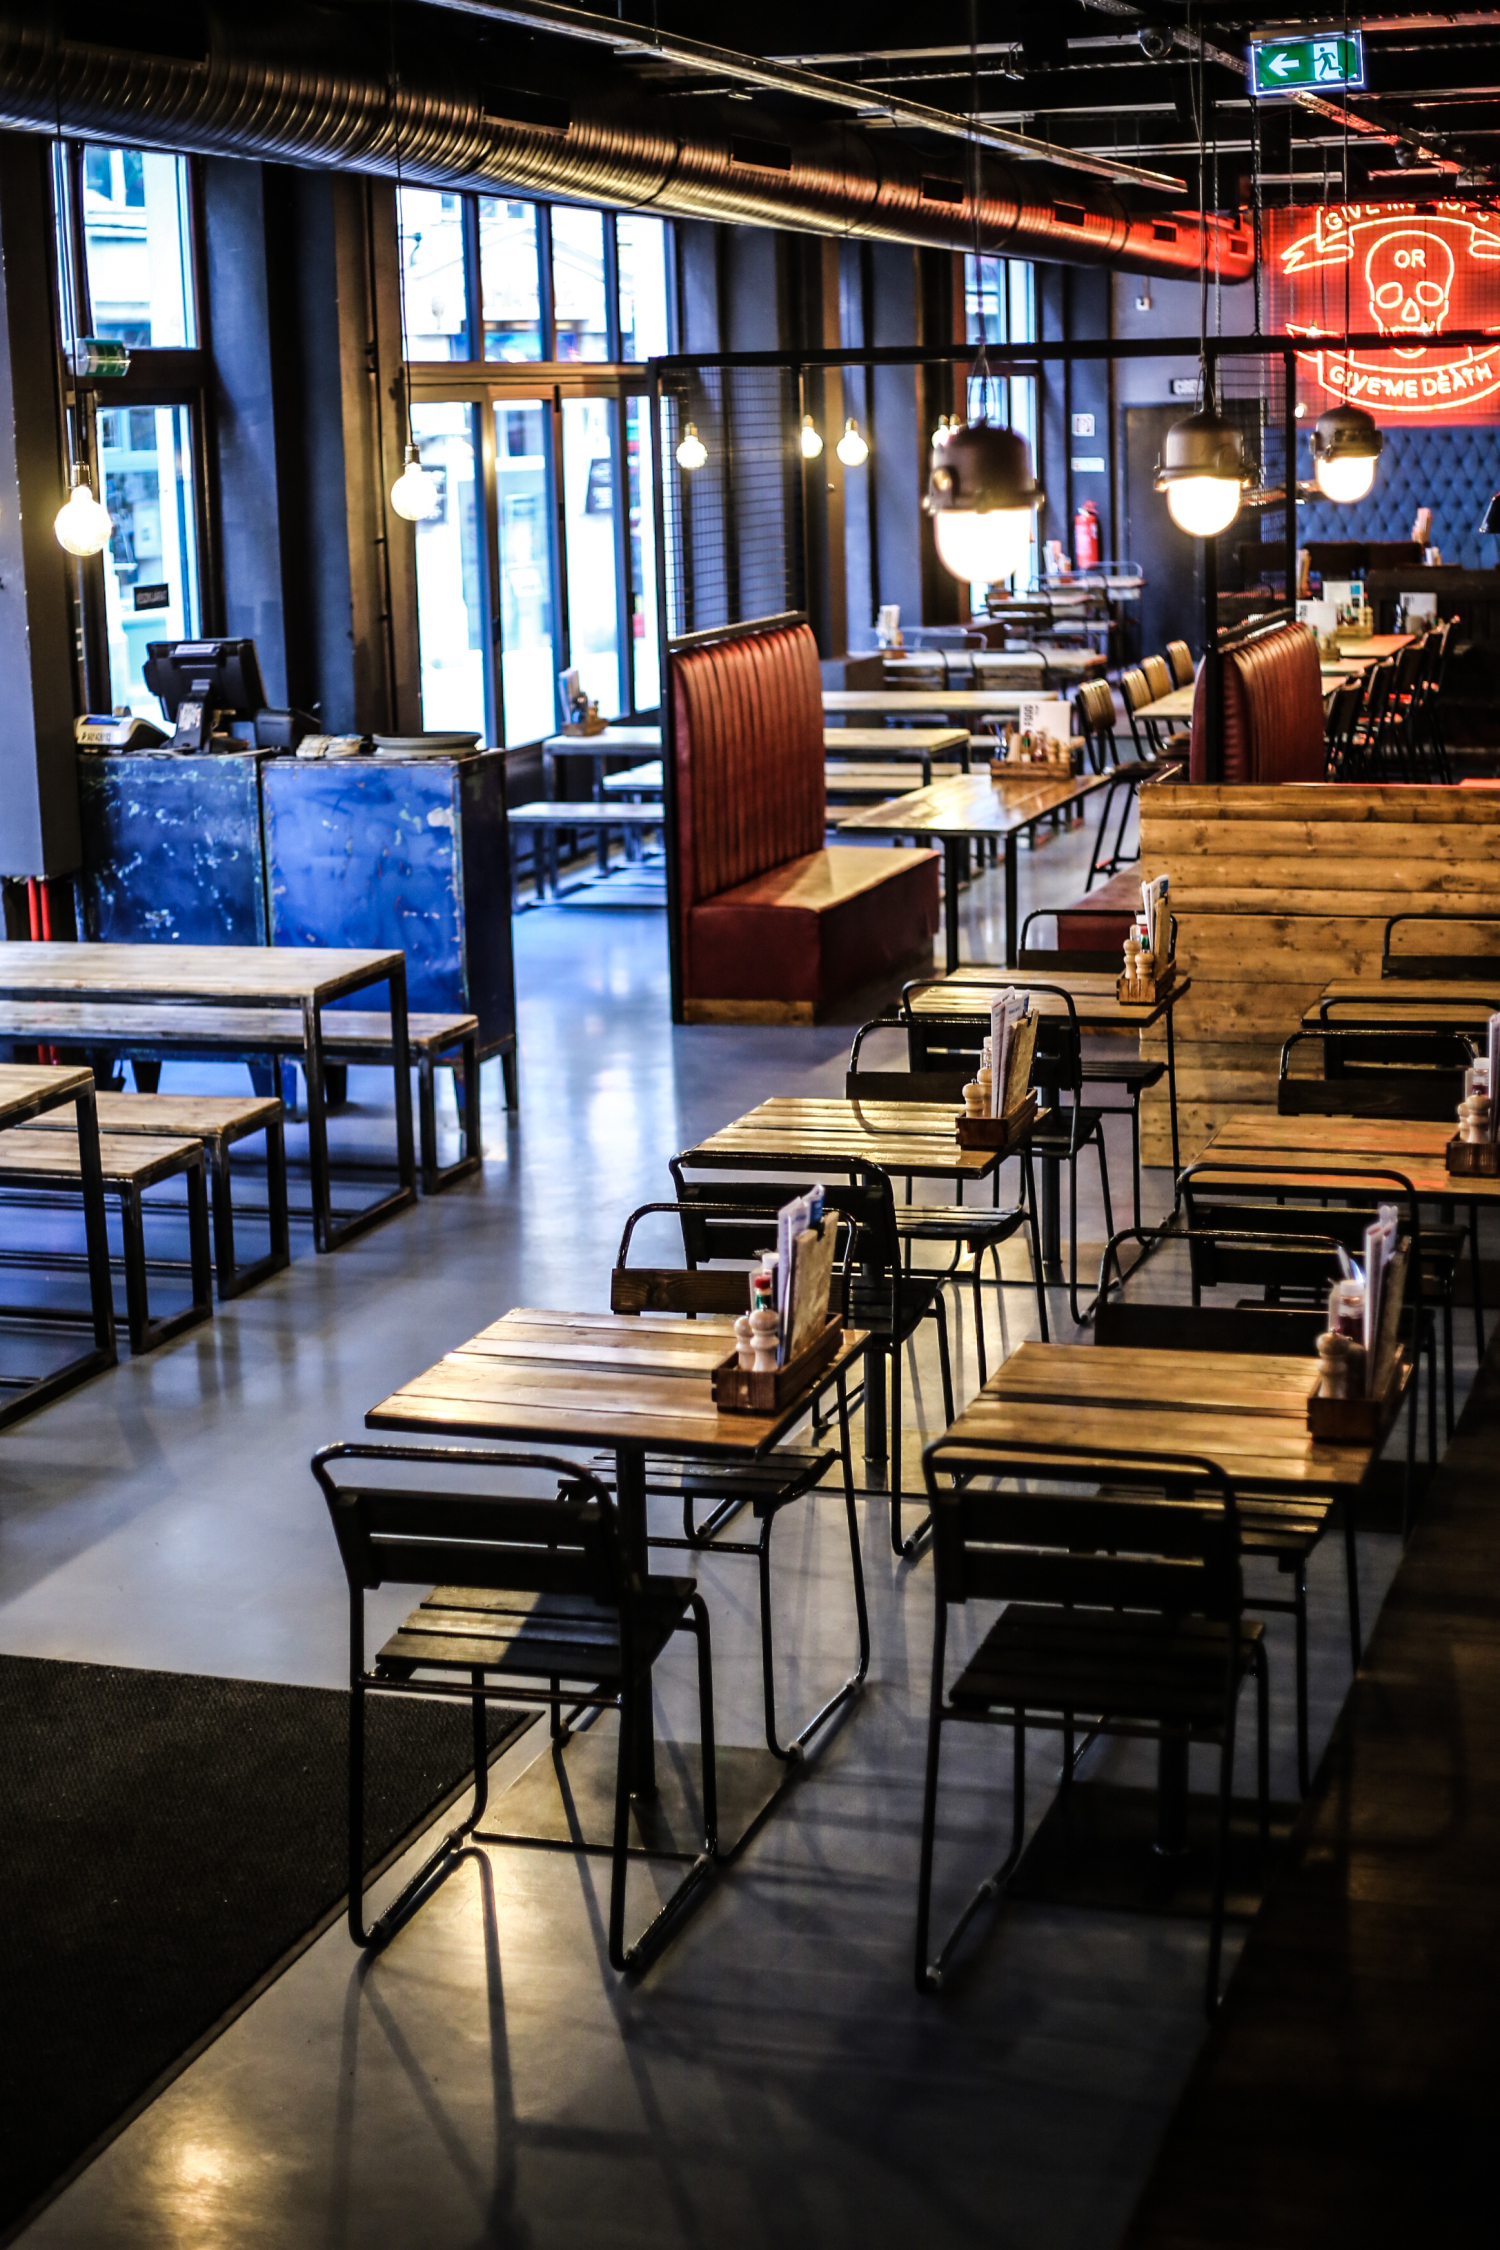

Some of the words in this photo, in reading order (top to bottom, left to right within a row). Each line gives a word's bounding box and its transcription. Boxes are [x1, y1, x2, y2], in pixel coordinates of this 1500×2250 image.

[1394, 248, 1426, 268] OR
[1329, 365, 1381, 396] GIVE
[1385, 378, 1418, 398] ME
[1421, 362, 1493, 397] DEATH
